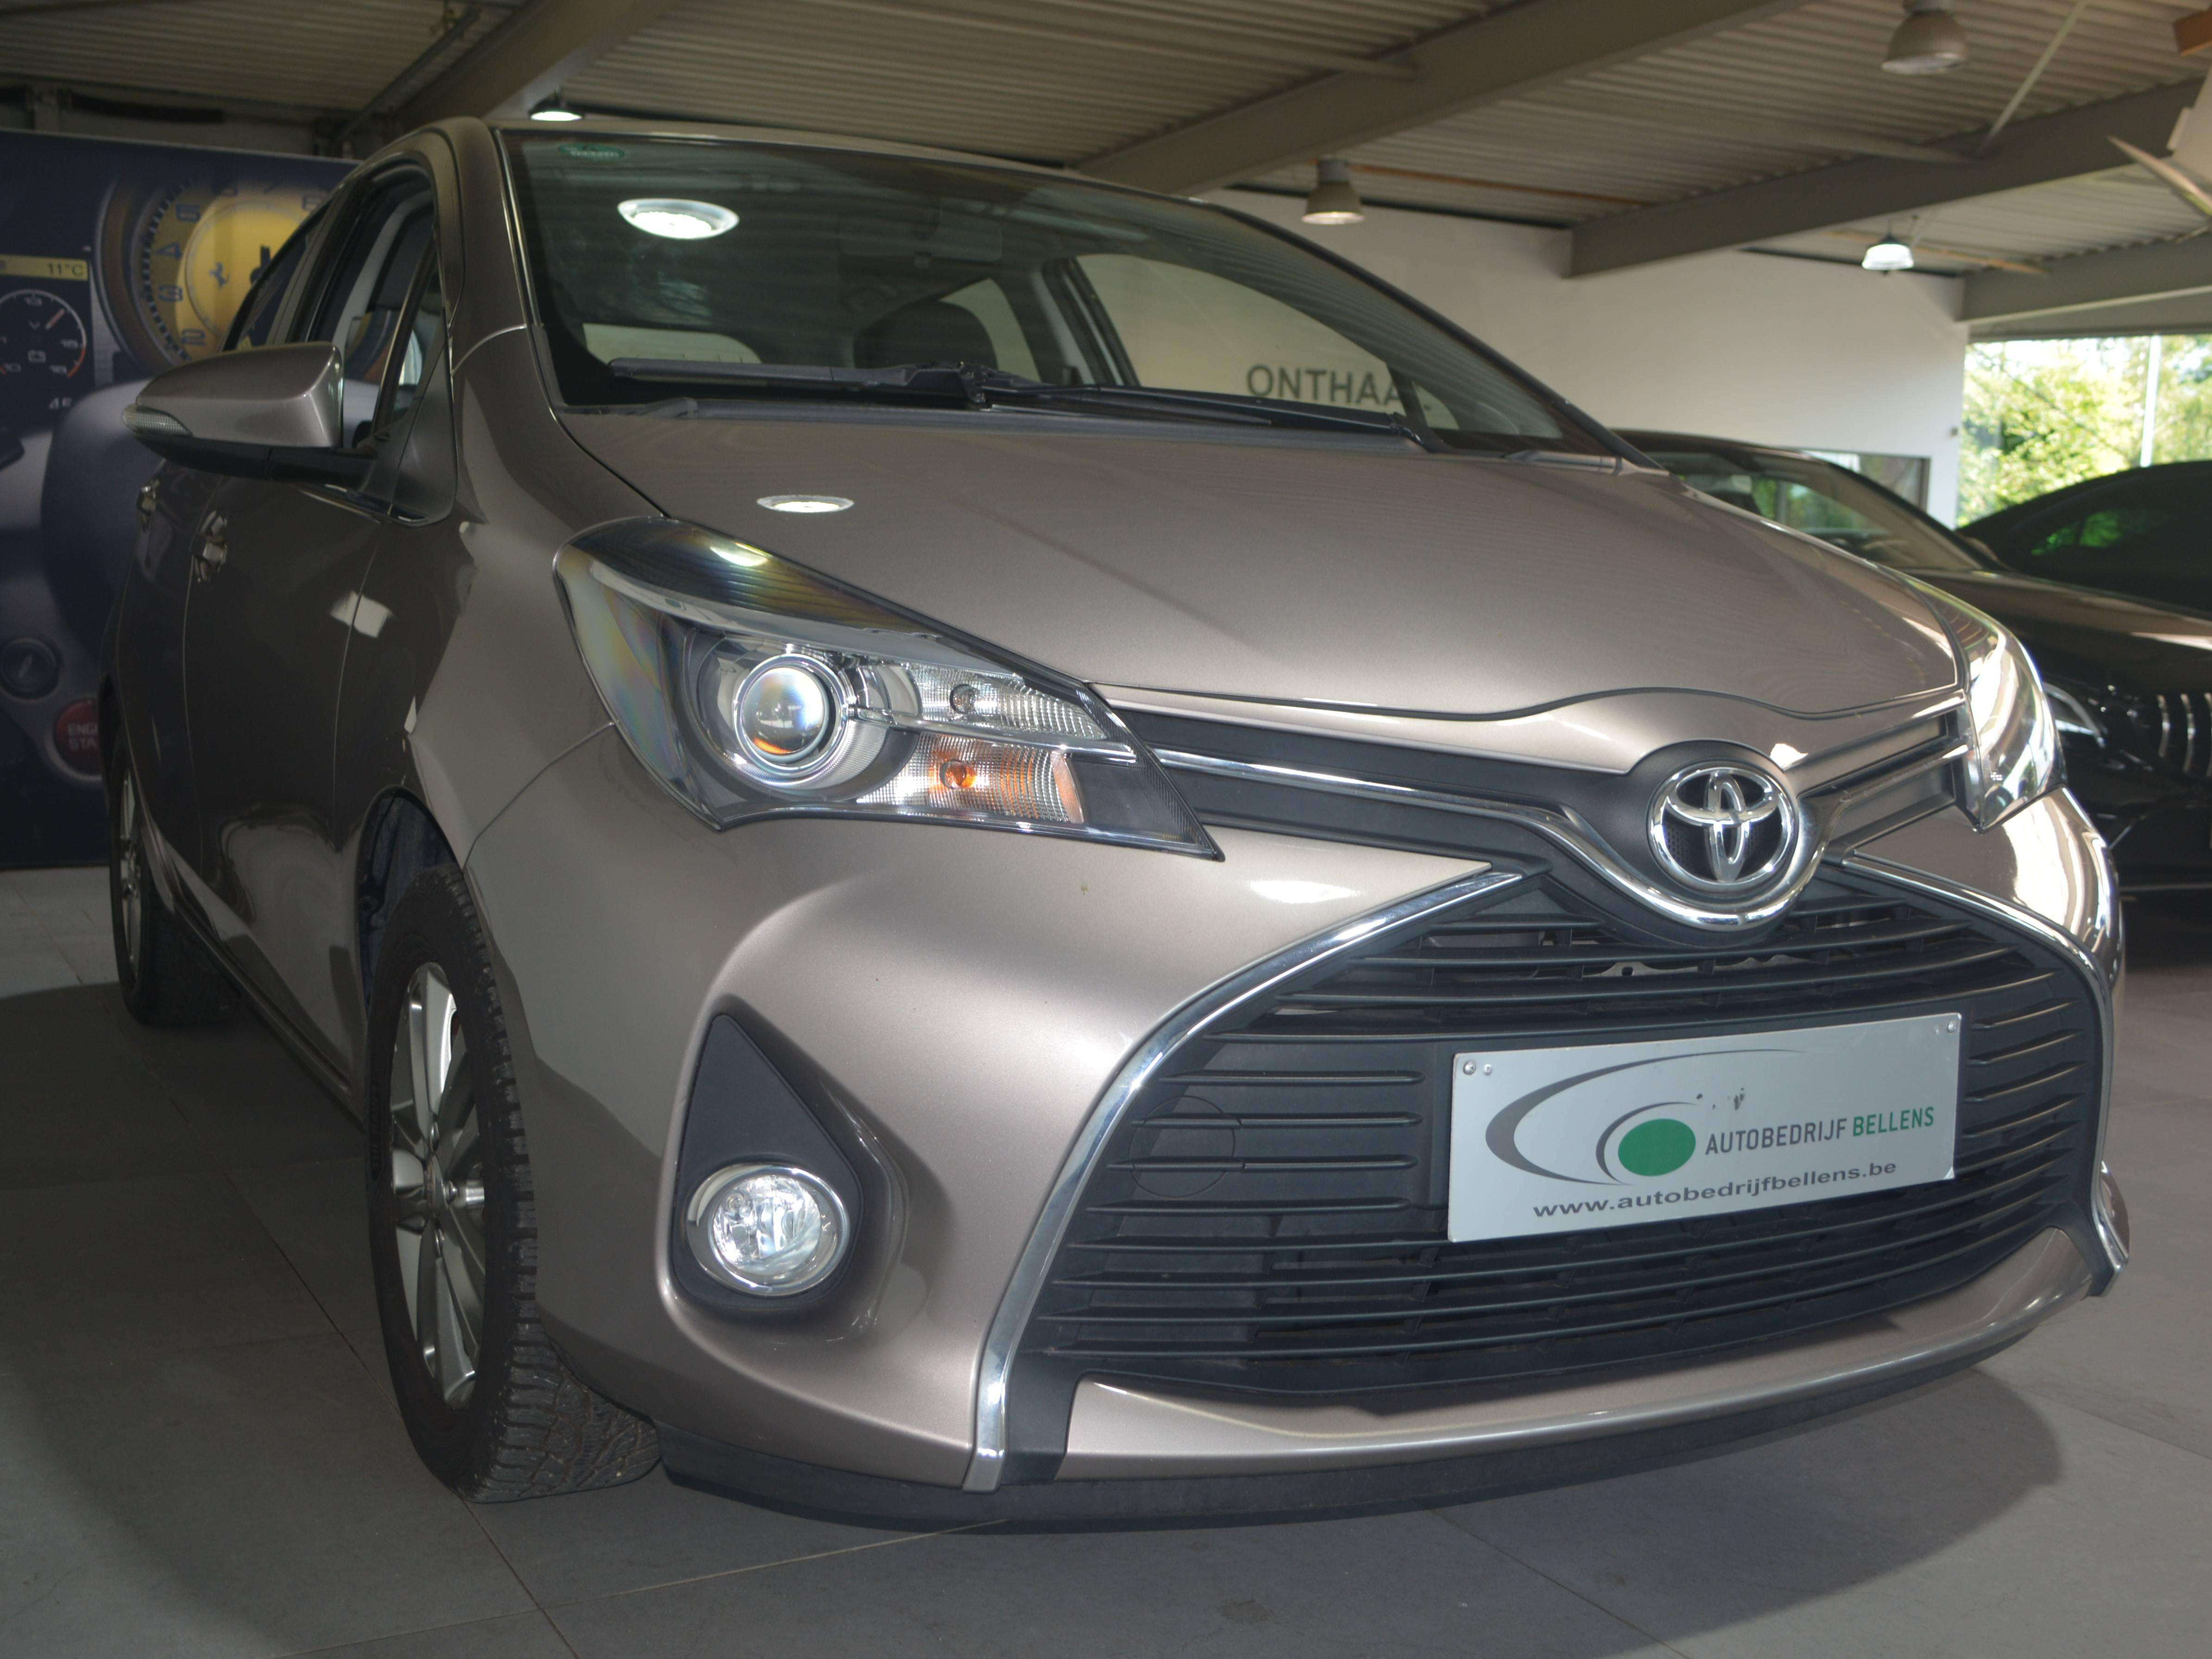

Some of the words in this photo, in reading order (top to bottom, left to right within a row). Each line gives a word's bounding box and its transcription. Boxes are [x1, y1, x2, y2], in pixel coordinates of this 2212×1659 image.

[156, 242, 182, 260] 4
[157, 285, 183, 302] 3
[181, 328, 206, 346] 2
[1247, 364, 1431, 410] ONTHAA
[68, 723, 98, 735] ENG
[68, 738, 98, 751] STA
[1705, 1118, 1847, 1156] AUTOBEDRIJF
[1853, 1106, 1934, 1137] BELLENS
[1533, 1163, 1897, 1217] www.autobedrijfbellens.be
